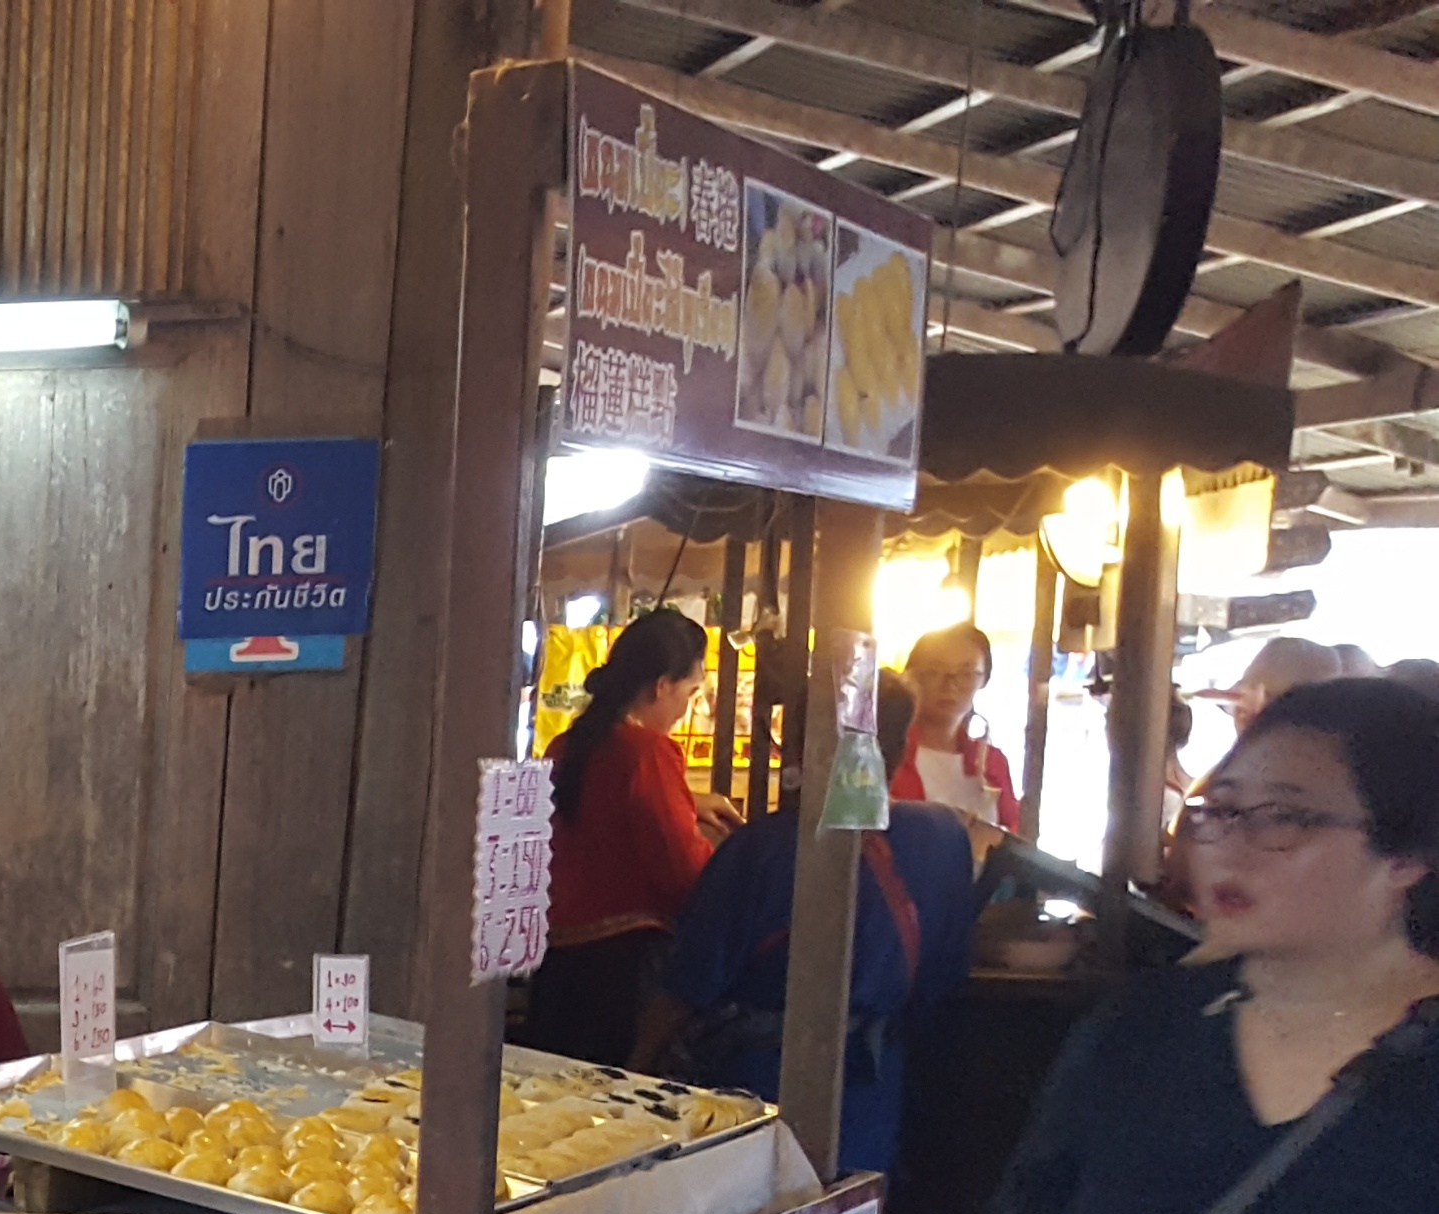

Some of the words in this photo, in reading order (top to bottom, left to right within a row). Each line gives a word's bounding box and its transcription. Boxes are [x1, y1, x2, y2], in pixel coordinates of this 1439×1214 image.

[207, 514, 327, 577] ไทย
[204, 581, 346, 611] ประกันชีวิต
